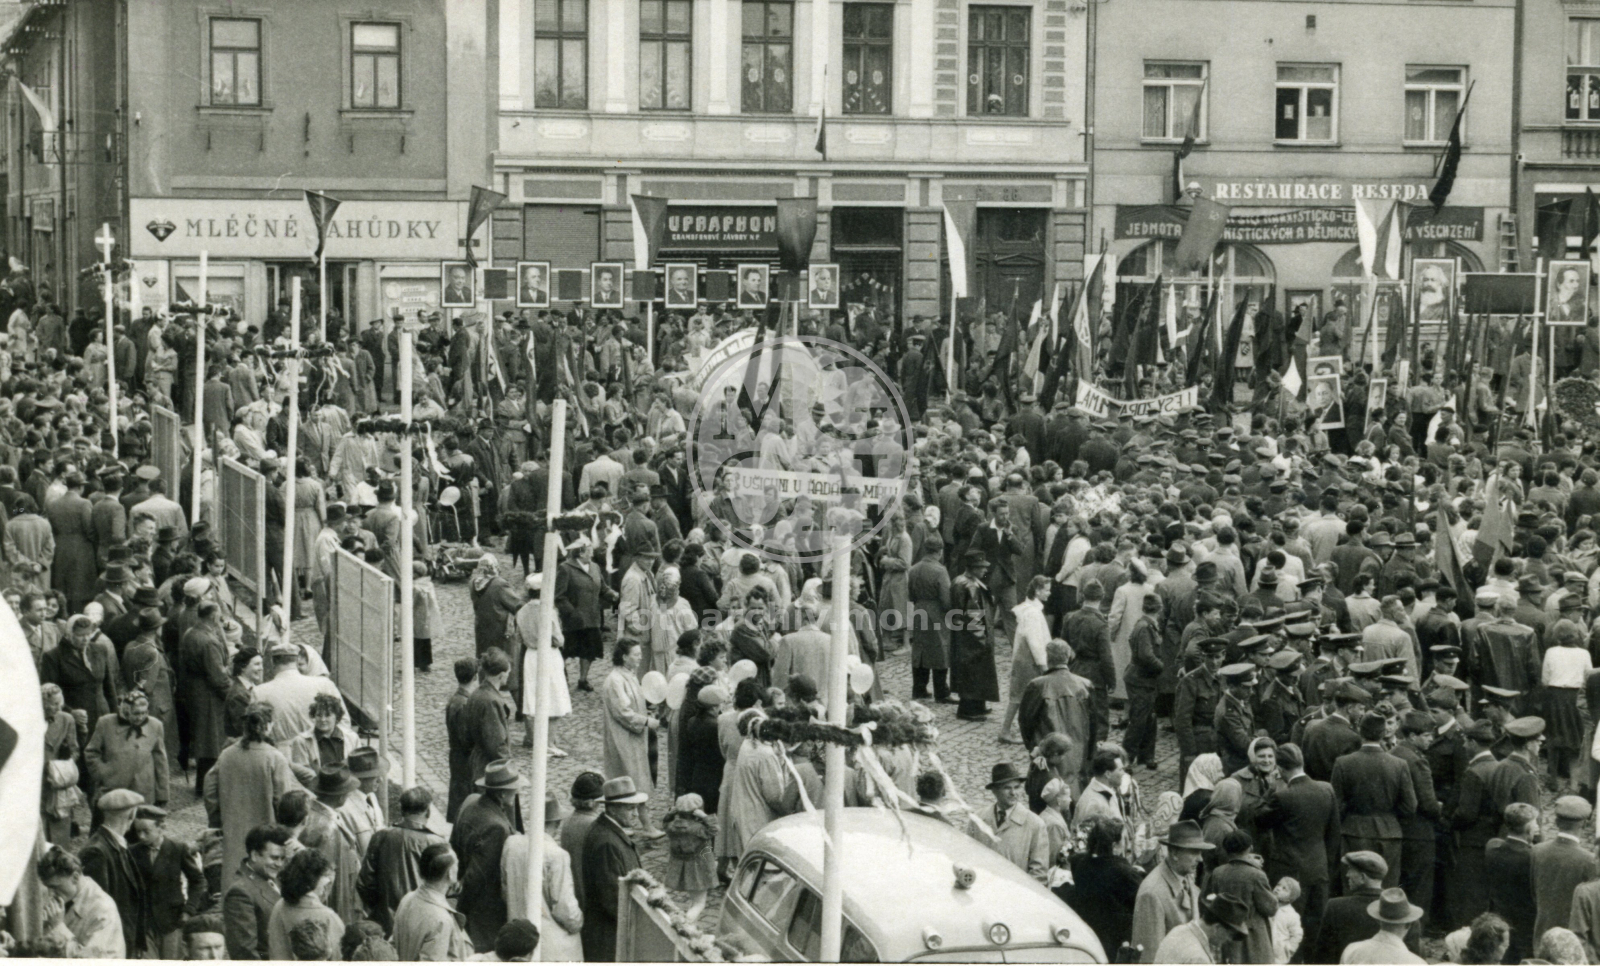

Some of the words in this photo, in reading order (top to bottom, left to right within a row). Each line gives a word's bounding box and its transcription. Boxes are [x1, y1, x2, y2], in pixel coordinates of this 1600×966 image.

[1215, 183, 1342, 200] RESTAURACE
[1351, 183, 1429, 201] BESEDA
[186, 213, 298, 239] MLÉČNÉ
[326, 215, 442, 240] AHŮDKY
[668, 215, 776, 233] UPRAPHON
[1296, 226, 1304, 240] A
[1307, 222, 1358, 240] DĚLNICKÝ
[807, 478, 841, 496] ŘADÁ
